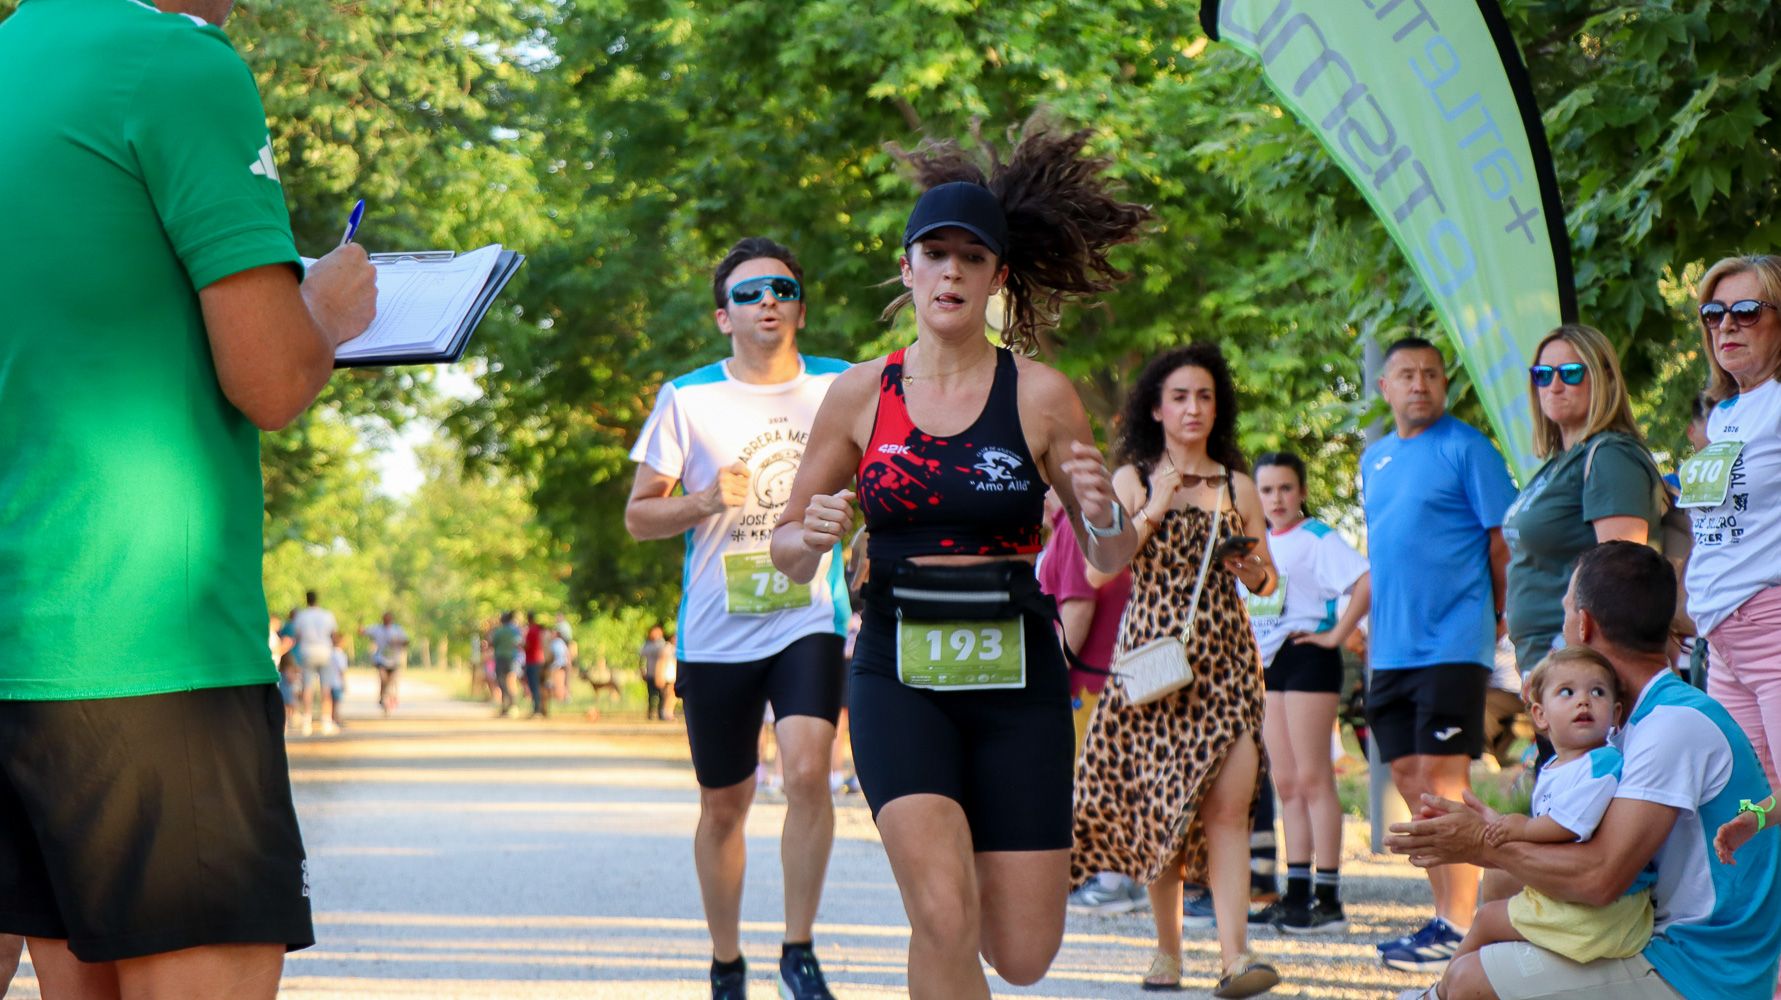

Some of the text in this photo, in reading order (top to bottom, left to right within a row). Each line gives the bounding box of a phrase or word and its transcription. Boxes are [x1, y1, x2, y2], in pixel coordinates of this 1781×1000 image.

[738, 430, 783, 464] ARRERA
[878, 444, 911, 454] 42K
[1686, 460, 1724, 484] 510
[752, 571, 790, 597] 78
[926, 628, 1003, 661] 193
